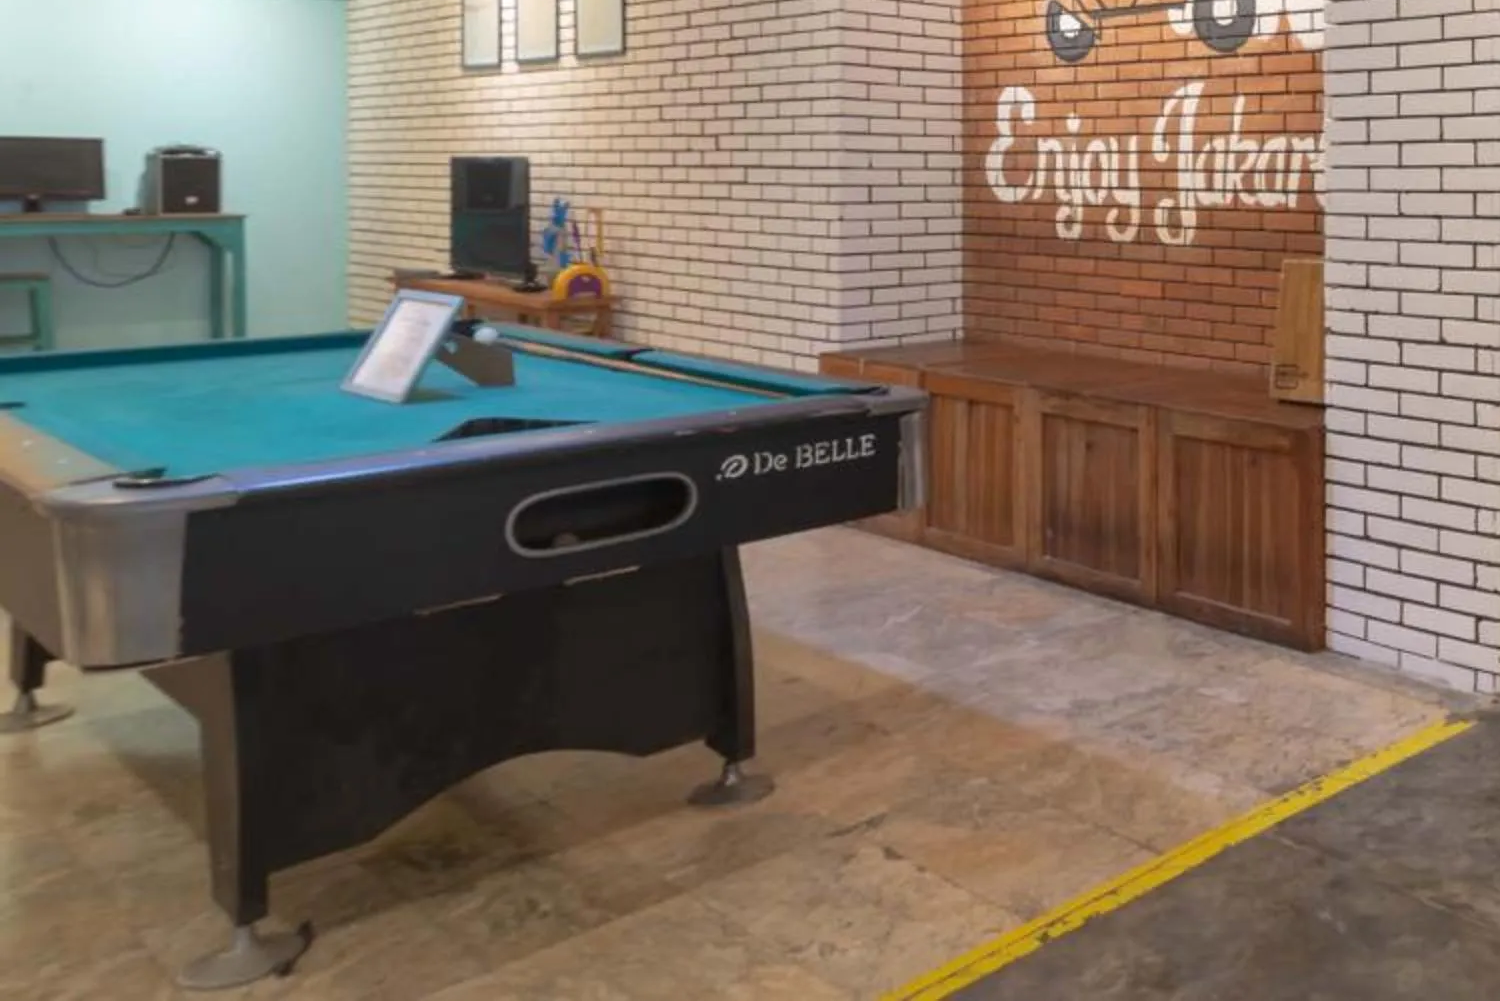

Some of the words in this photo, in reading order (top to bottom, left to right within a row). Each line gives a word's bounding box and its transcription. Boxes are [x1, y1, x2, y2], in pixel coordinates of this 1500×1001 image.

[985, 86, 1140, 242] Enjoy
[753, 451, 787, 475] De
[796, 434, 876, 469] BELLE
